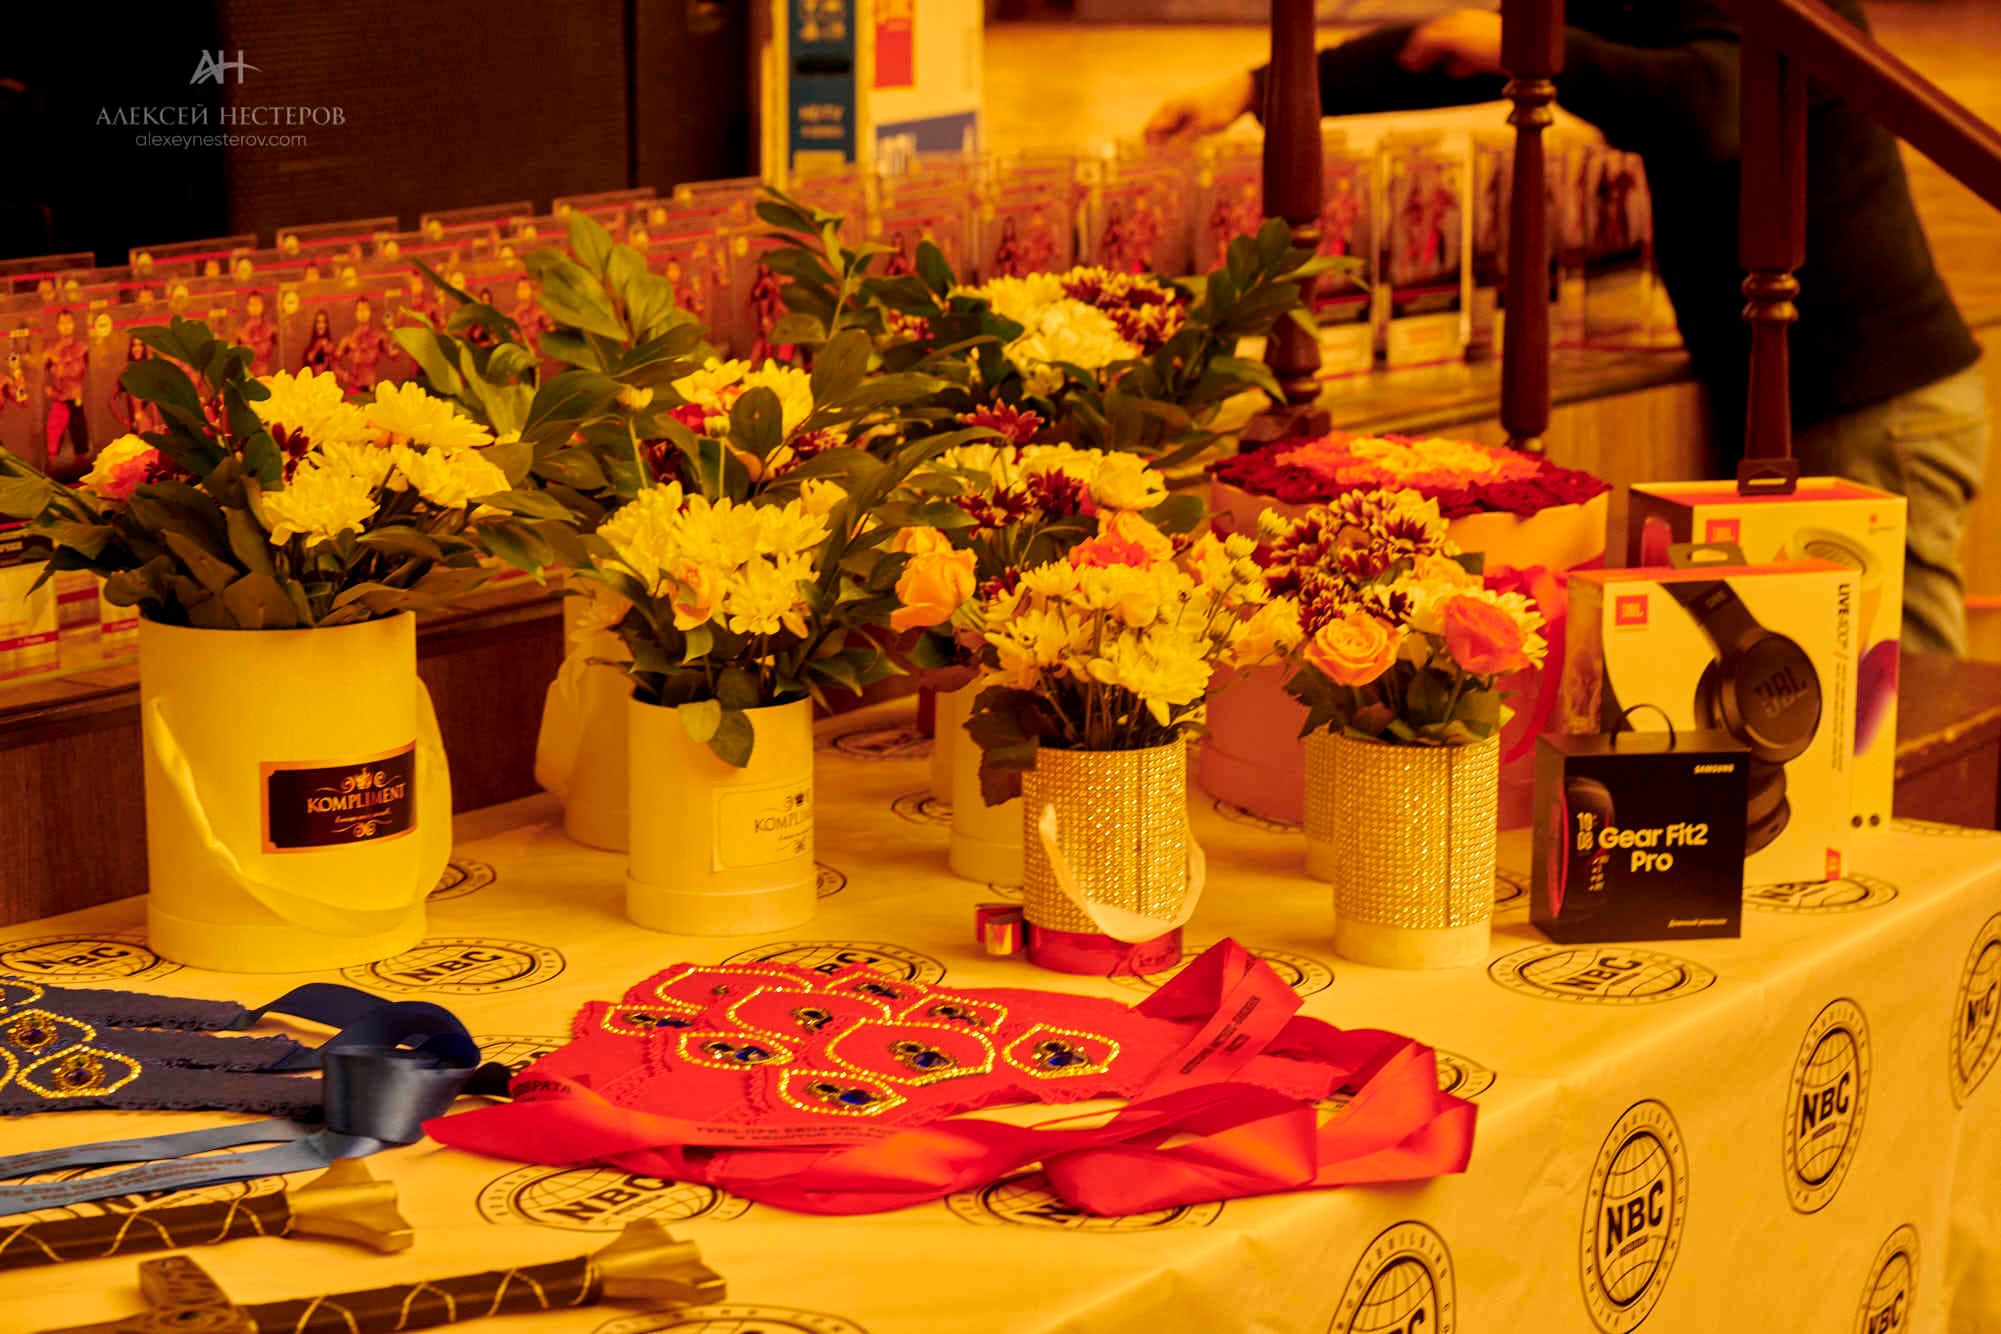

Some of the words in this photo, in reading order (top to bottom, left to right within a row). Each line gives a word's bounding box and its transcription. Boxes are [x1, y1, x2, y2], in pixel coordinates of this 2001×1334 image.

[306, 782, 406, 814] KOMPLIMENT
[1598, 826, 1664, 849] Gear
[1666, 822, 1709, 847] Fit2
[1630, 850, 1674, 873] Pro
[393, 951, 503, 982] NBC
[1552, 956, 1643, 991] NBC
[1799, 1071, 1850, 1139] NBC
[542, 1173, 676, 1222] NBC
[1605, 1179, 1664, 1258] NBC
